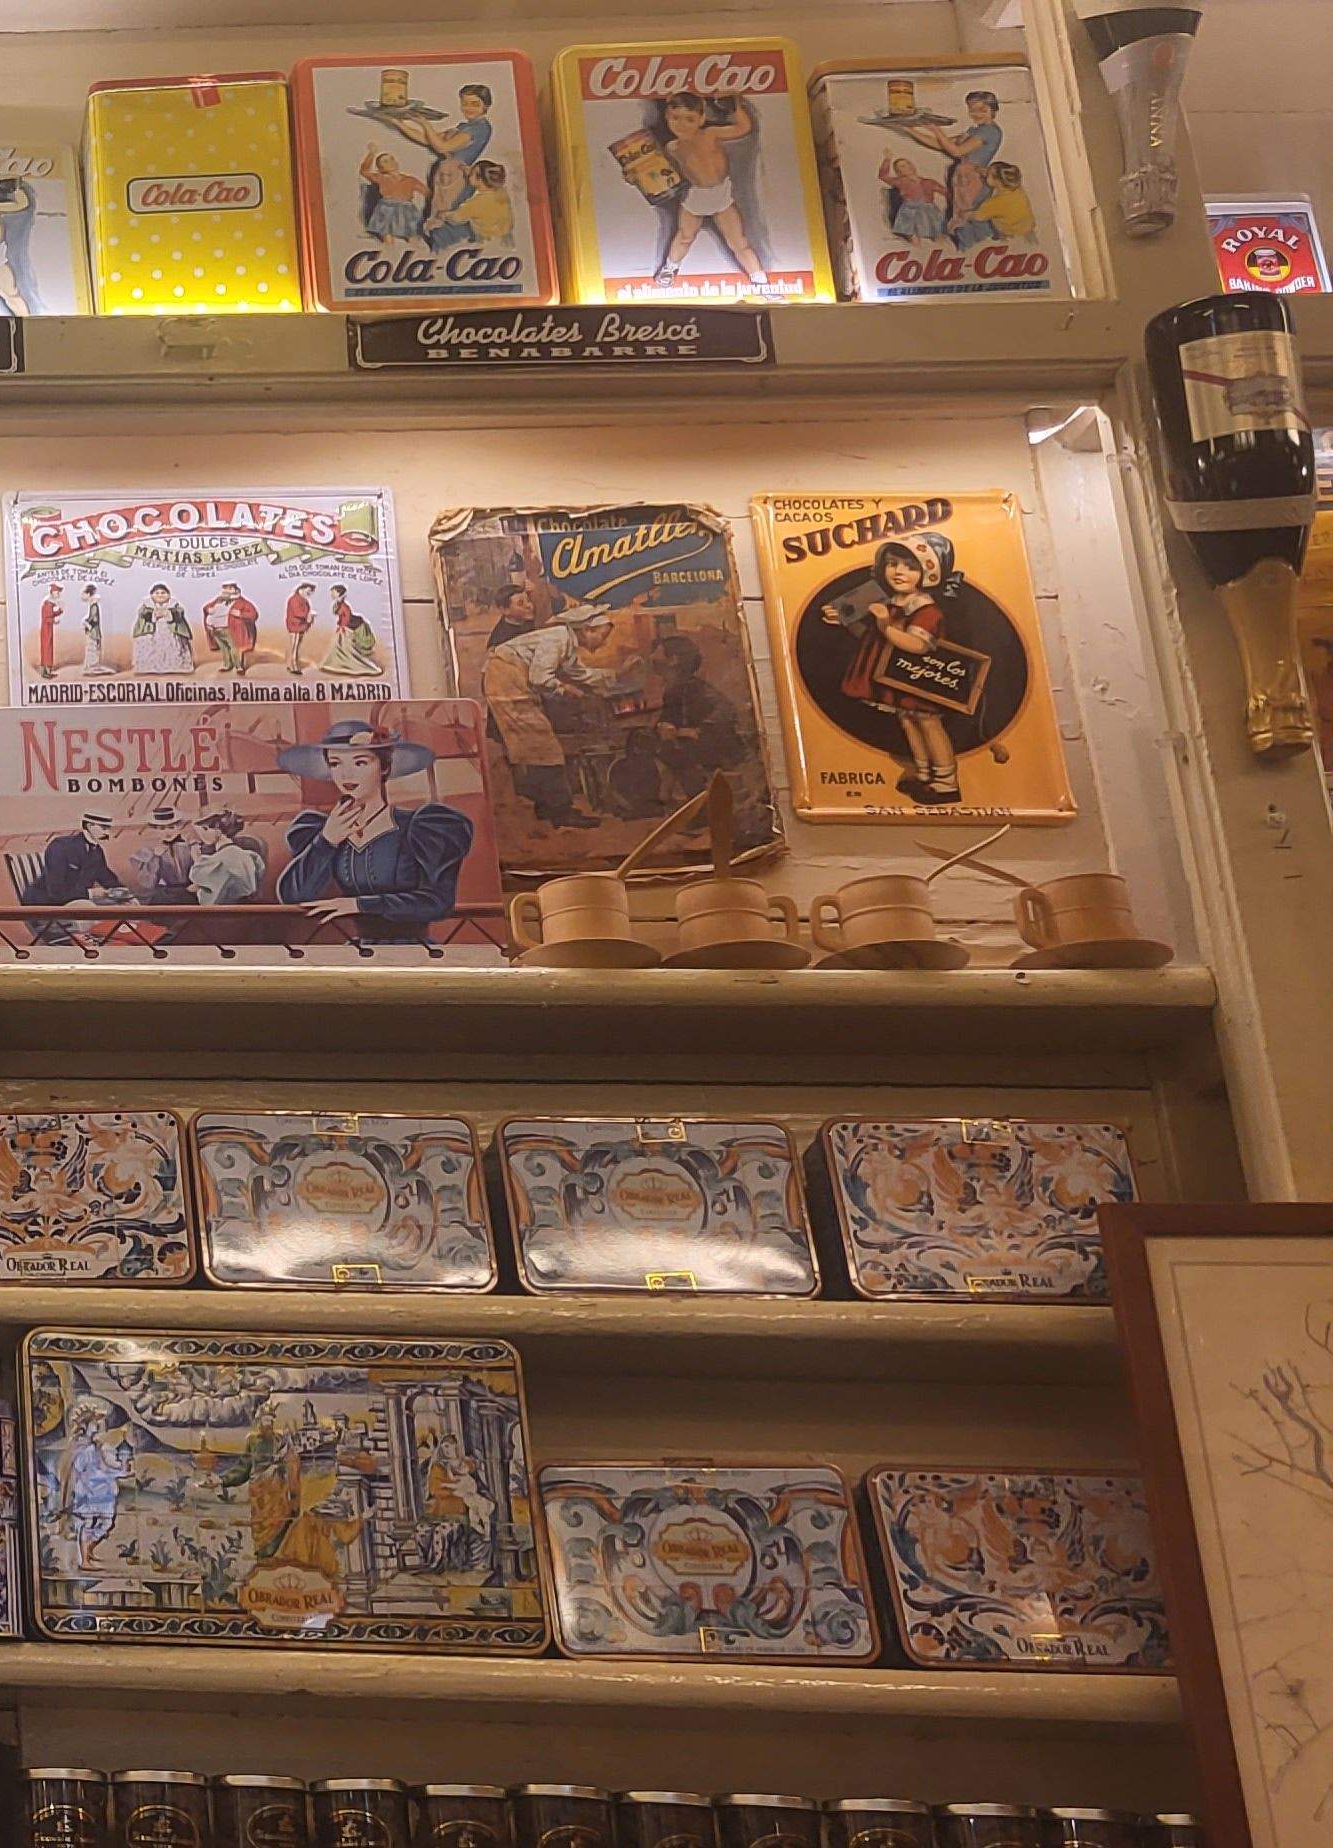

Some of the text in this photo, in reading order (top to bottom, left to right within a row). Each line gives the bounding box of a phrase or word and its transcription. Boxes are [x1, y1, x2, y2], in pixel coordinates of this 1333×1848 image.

[1221, 225, 1301, 253] ROYAL
[344, 247, 524, 284] Cola-Cao
[876, 245, 1049, 285] Cola-Cao
[417, 311, 700, 345] Chocolates Brescó
[427, 345, 698, 359] BENABARRE
[773, 498, 883, 511] CHOCOLATES Y
[774, 512, 834, 523] CACAOS
[31, 501, 337, 557] CHOCOLATES
[783, 497, 954, 564] SUCHARD
[134, 543, 263, 564] MATIAS LOPEZ
[164, 537, 240, 549] Y DULCES
[652, 568, 724, 585] BARCELONA
[922, 653, 967, 677] son los
[28, 683, 165, 703] MADRID-ESCORIAL
[232, 682, 280, 702] Palma
[316, 683, 326, 701] 8
[330, 683, 393, 702] MADRID
[20, 713, 220, 793] NESTLÉ
[66, 774, 224, 795] BOMBONES
[820, 771, 885, 786] FABRICA
[914, 804, 1013, 817] SEBASTIAN
[58, 1257, 91, 1272] REAL
